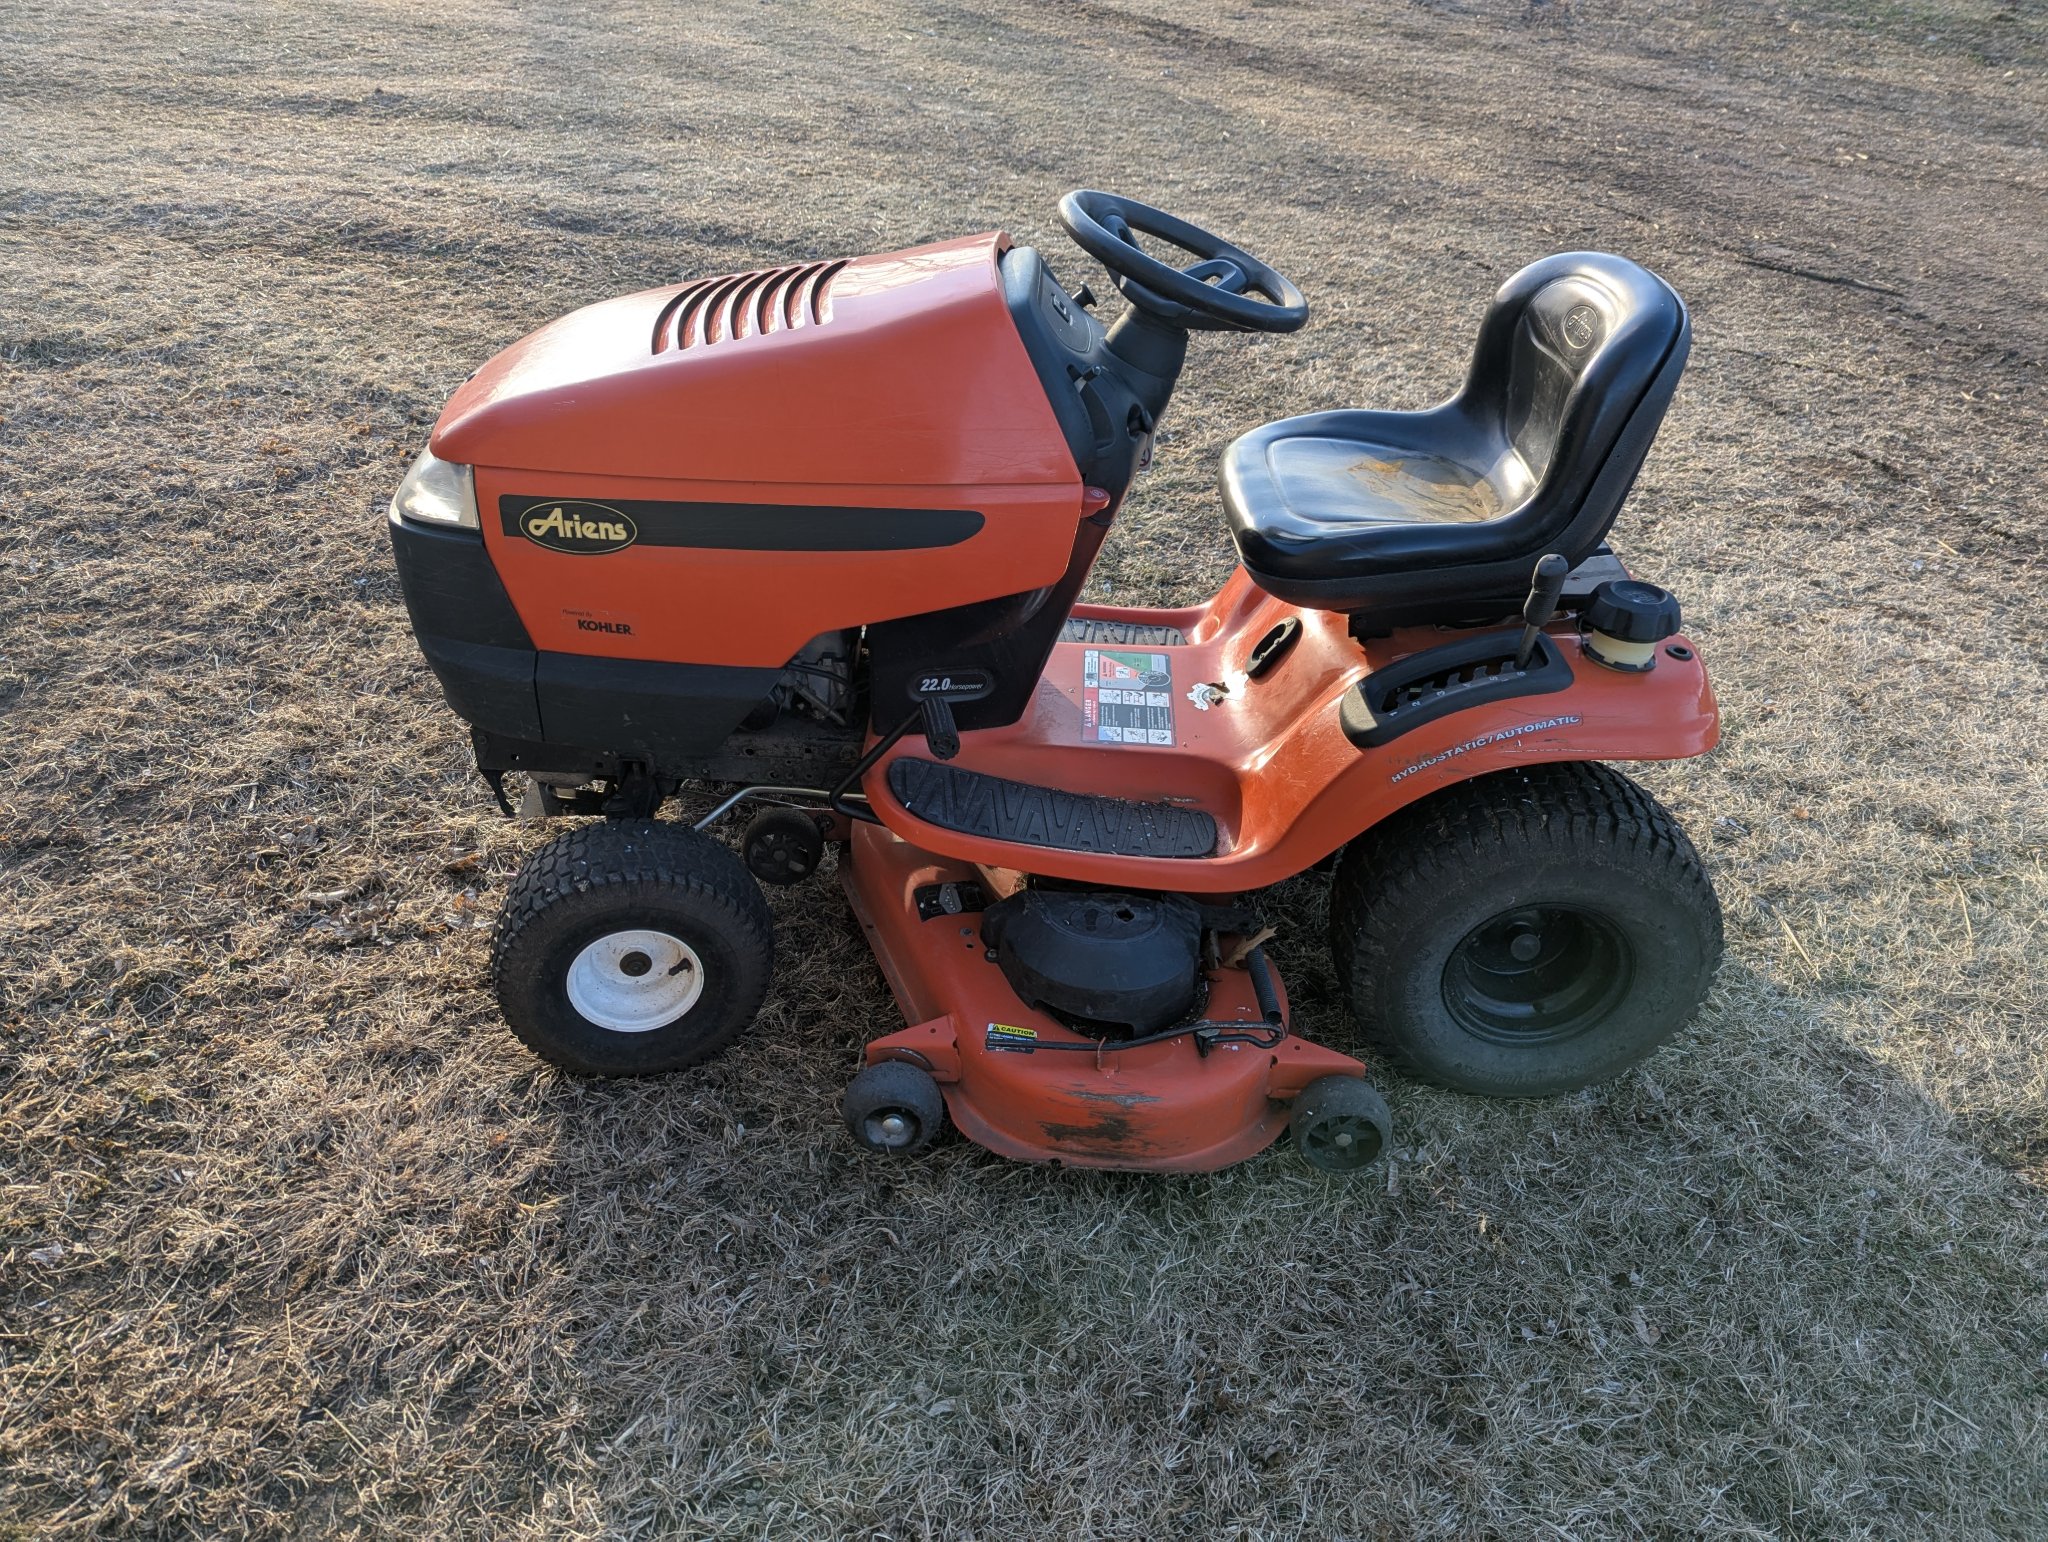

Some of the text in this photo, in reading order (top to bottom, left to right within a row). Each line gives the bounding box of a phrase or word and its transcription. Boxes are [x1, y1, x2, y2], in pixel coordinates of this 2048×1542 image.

[528, 507, 628, 541] Ariens
[577, 619, 633, 636] KOHLER
[920, 677, 984, 692] 22.0 Horsepower
[1001, 1026, 1035, 1036] CAUTION
